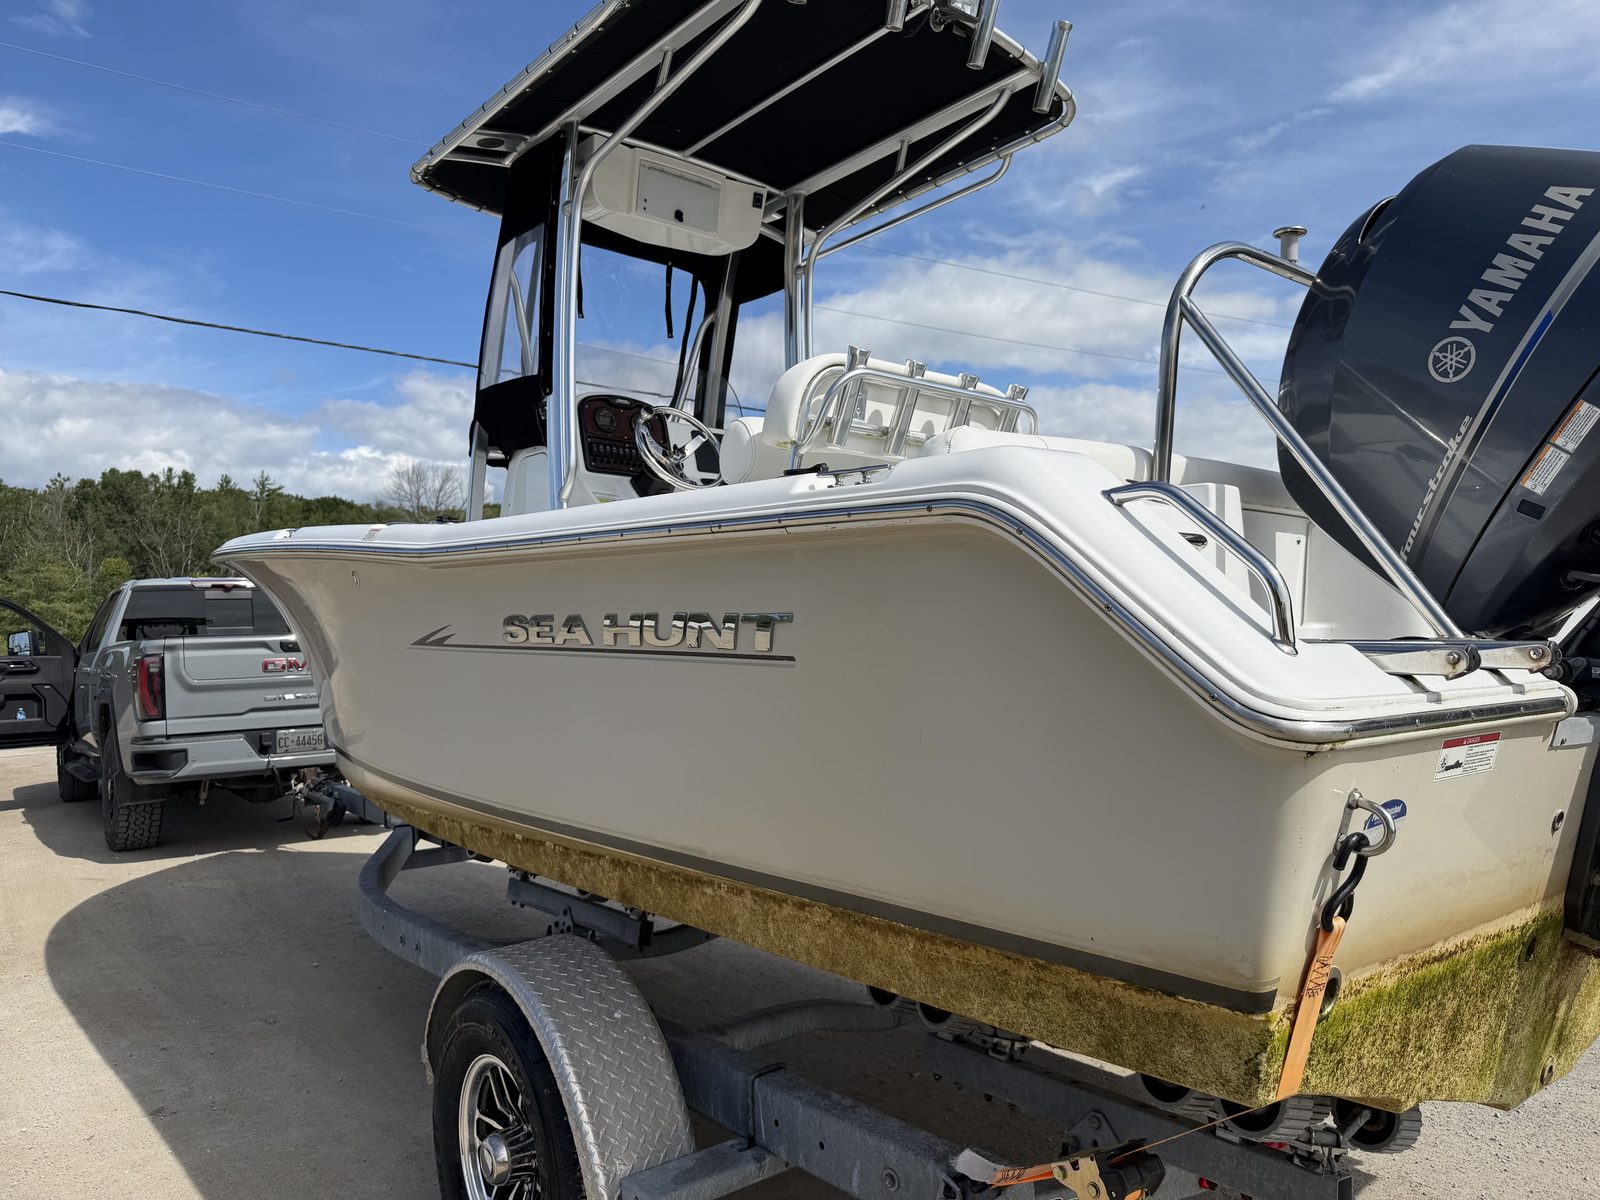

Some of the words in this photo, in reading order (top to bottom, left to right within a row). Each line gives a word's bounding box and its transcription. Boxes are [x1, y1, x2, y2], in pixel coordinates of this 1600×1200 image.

[1449, 185, 1595, 334] YAMAHA
[1400, 508, 1423, 562] four
[1423, 415, 1472, 505] stroke
[262, 657, 310, 673] GM
[502, 613, 593, 646] SEA
[602, 612, 794, 652] HUNT
